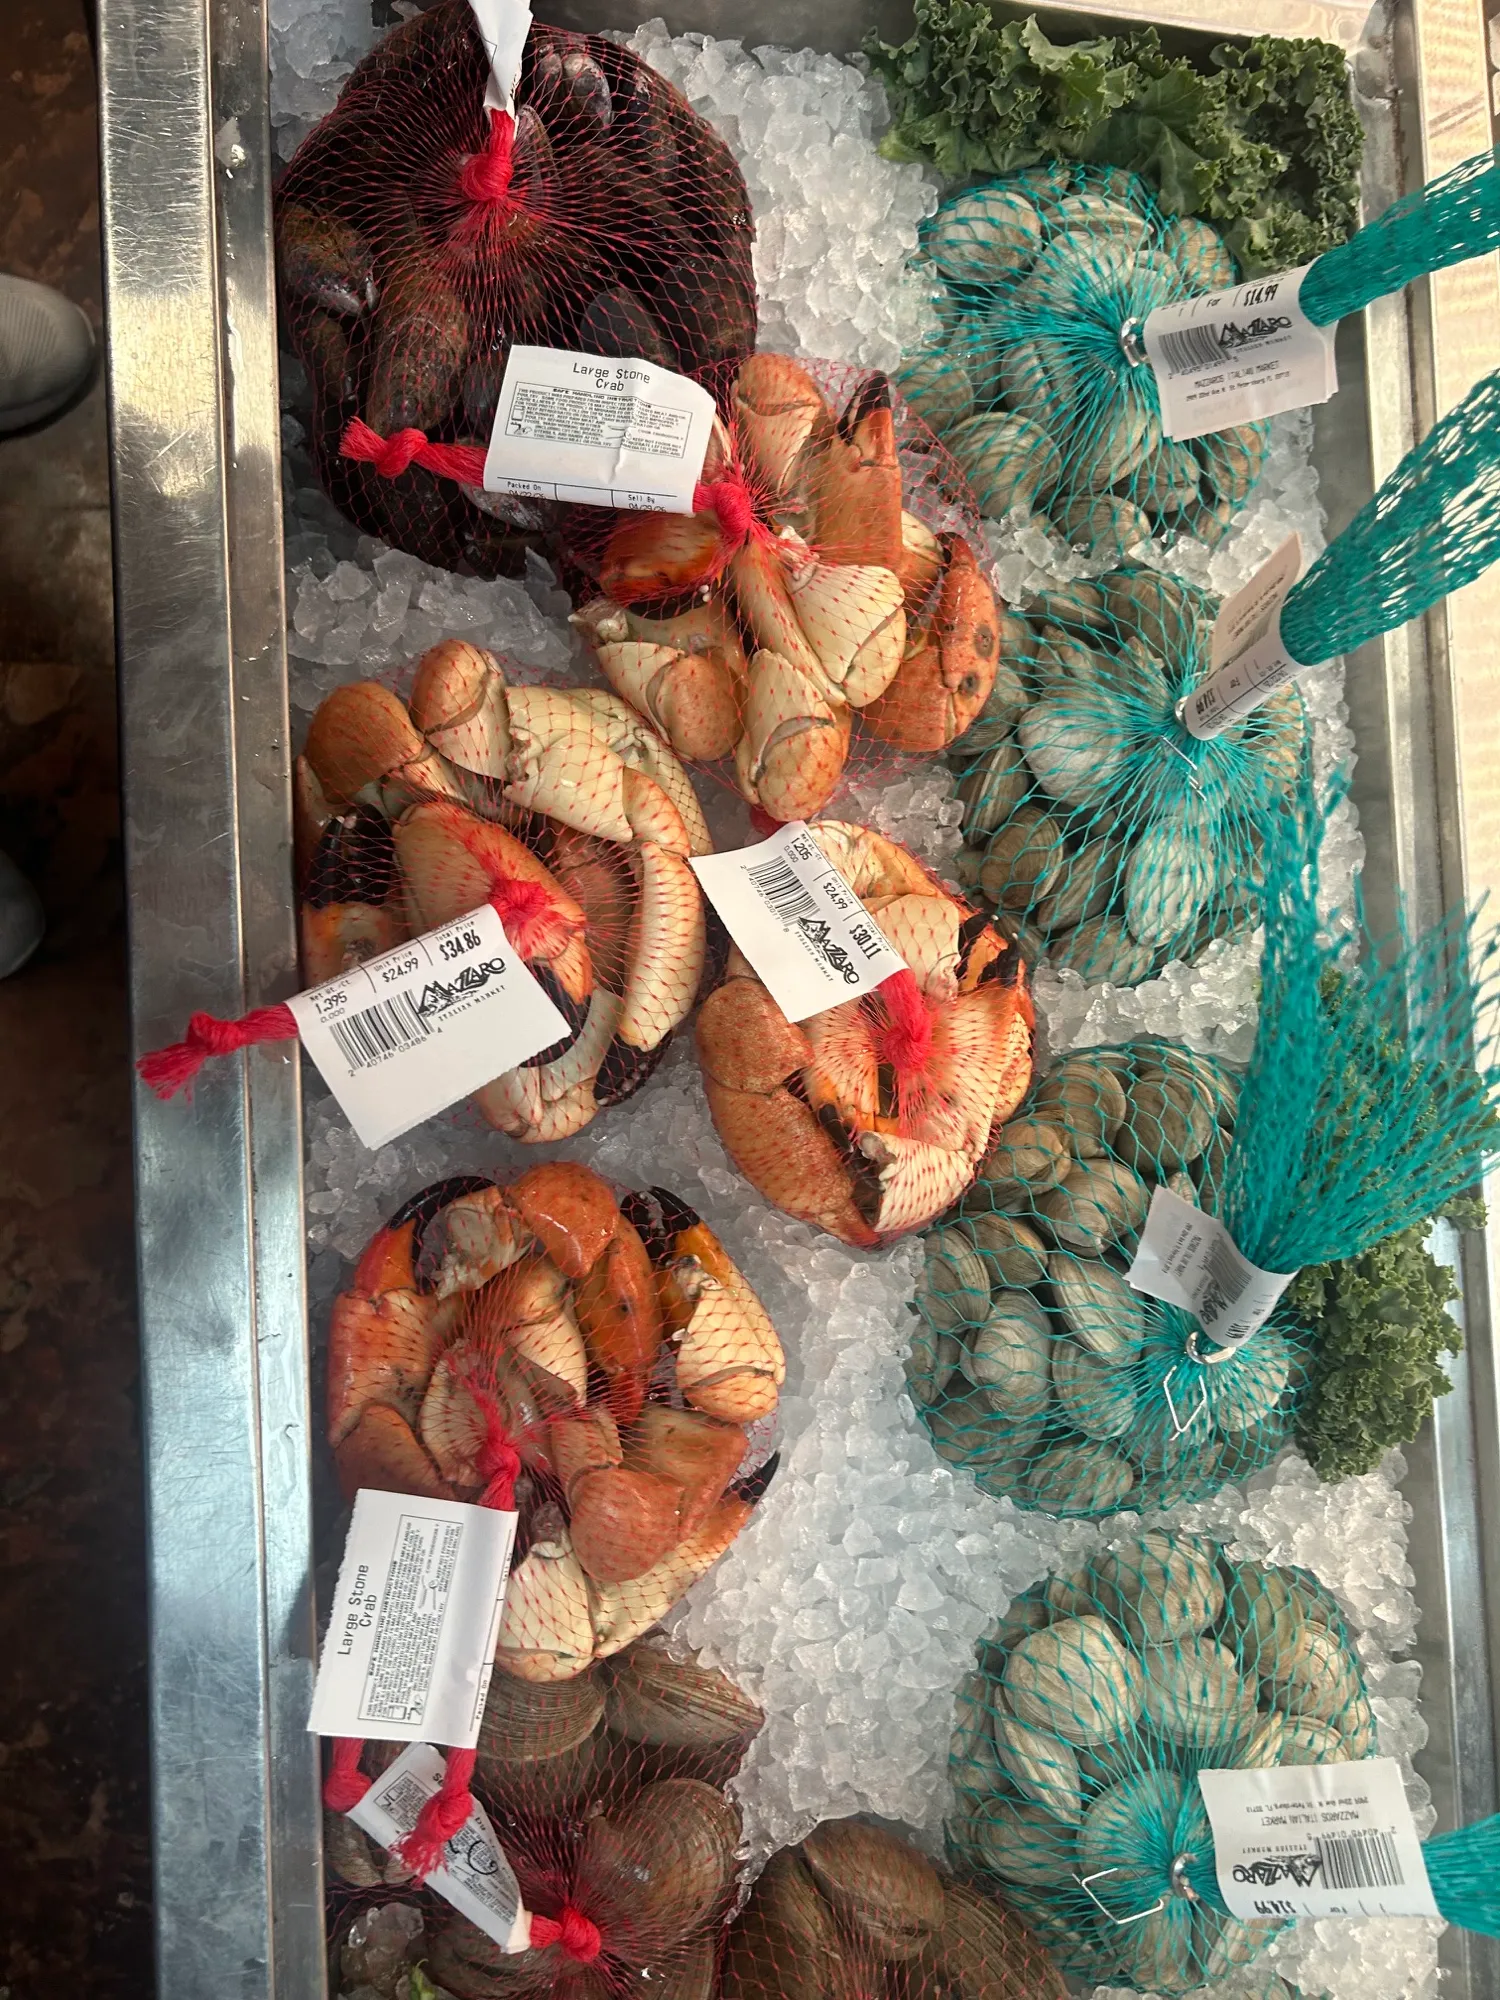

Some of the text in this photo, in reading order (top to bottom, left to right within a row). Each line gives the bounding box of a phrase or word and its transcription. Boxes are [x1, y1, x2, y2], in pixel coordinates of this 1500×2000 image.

[1243, 283, 1279, 307] $14.99
[573, 362, 651, 384] Large Stone
[596, 378, 625, 392] Crab
[507, 481, 531, 491] Packed
[533, 483, 542, 491] On
[628, 494, 643, 502] Sell
[783, 845, 799, 863] 0.000
[790, 837, 883, 961] 1.205 $24.99 $30.11
[373, 961, 391, 972] Unit
[392, 951, 412, 963] Price
[434, 930, 453, 942] Total
[455, 921, 474, 932] Price
[798, 917, 860, 985] MAZZARO
[315, 929, 481, 1014] 1.395 $24.99 $34.86
[418, 957, 507, 1017] MAZZARO
[474, 985, 505, 1003] MARKET
[320, 1007, 345, 1023] 0.000
[366, 1051, 394, 1068] 40746
[398, 1035, 428, 1053] 03486
[337, 1565, 369, 1655] Large Stone
[357, 1594, 377, 1627] Crab
[1232, 1853, 1324, 1888] MAZZARO
[1254, 1900, 1296, 1914] $14.99
